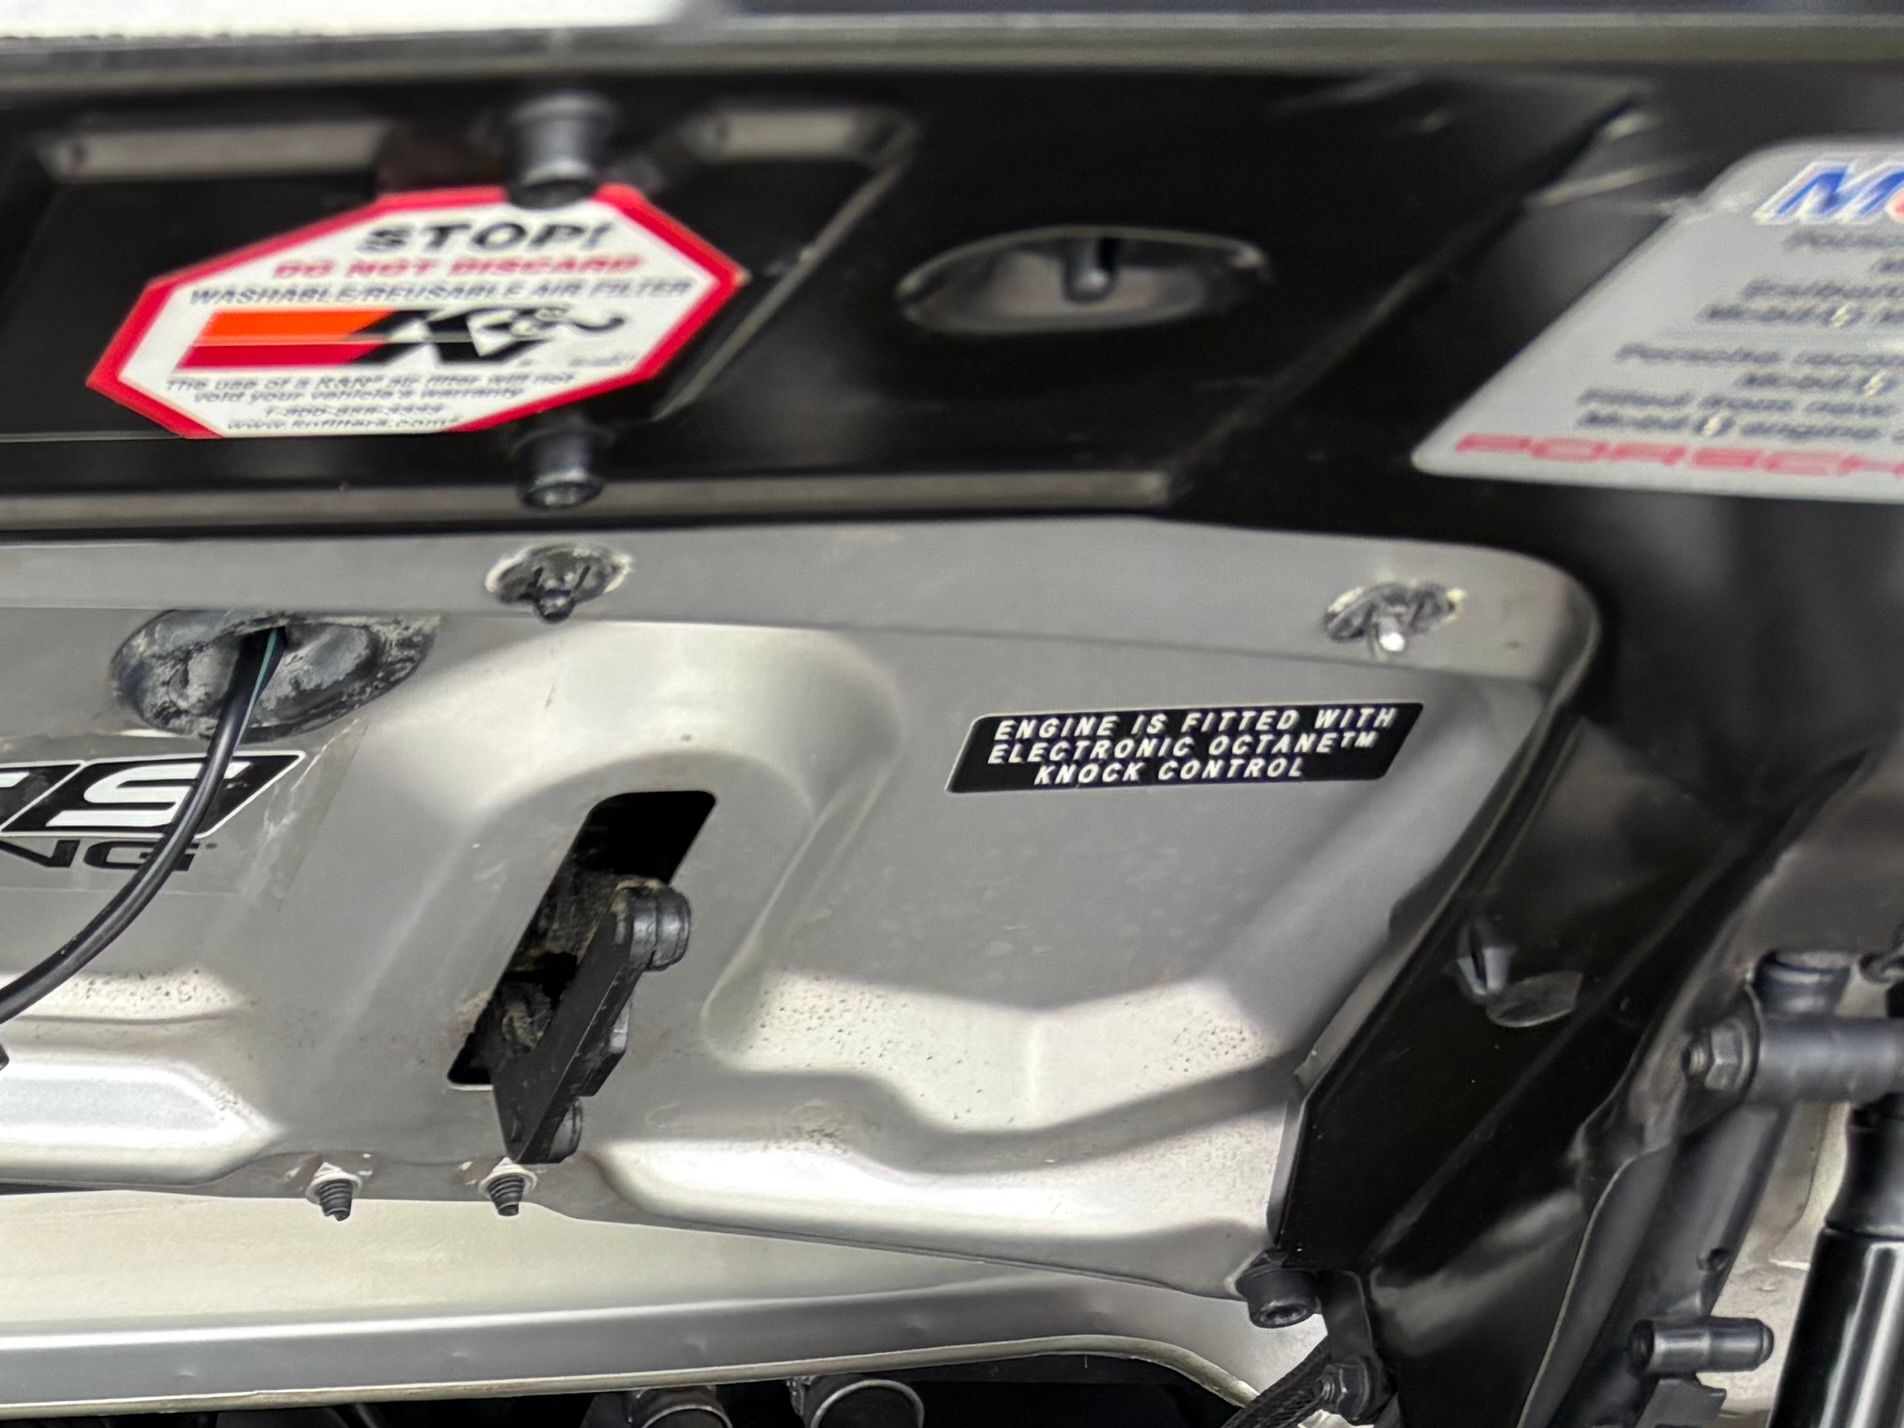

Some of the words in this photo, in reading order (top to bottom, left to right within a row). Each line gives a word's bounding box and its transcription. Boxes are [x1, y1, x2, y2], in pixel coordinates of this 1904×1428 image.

[1754, 159, 1904, 225] M
[357, 220, 614, 253] STOP!
[346, 257, 434, 279] NOT
[450, 254, 646, 277] DISCARD
[993, 714, 1120, 742] ENGINE
[1131, 712, 1176, 737] IS
[1180, 709, 1301, 734] FITTED
[1314, 707, 1399, 731] WITH
[987, 736, 1197, 765] ELECTRONIC
[1034, 760, 1144, 788] KNOCK
[1157, 755, 1306, 782] CONTROL
